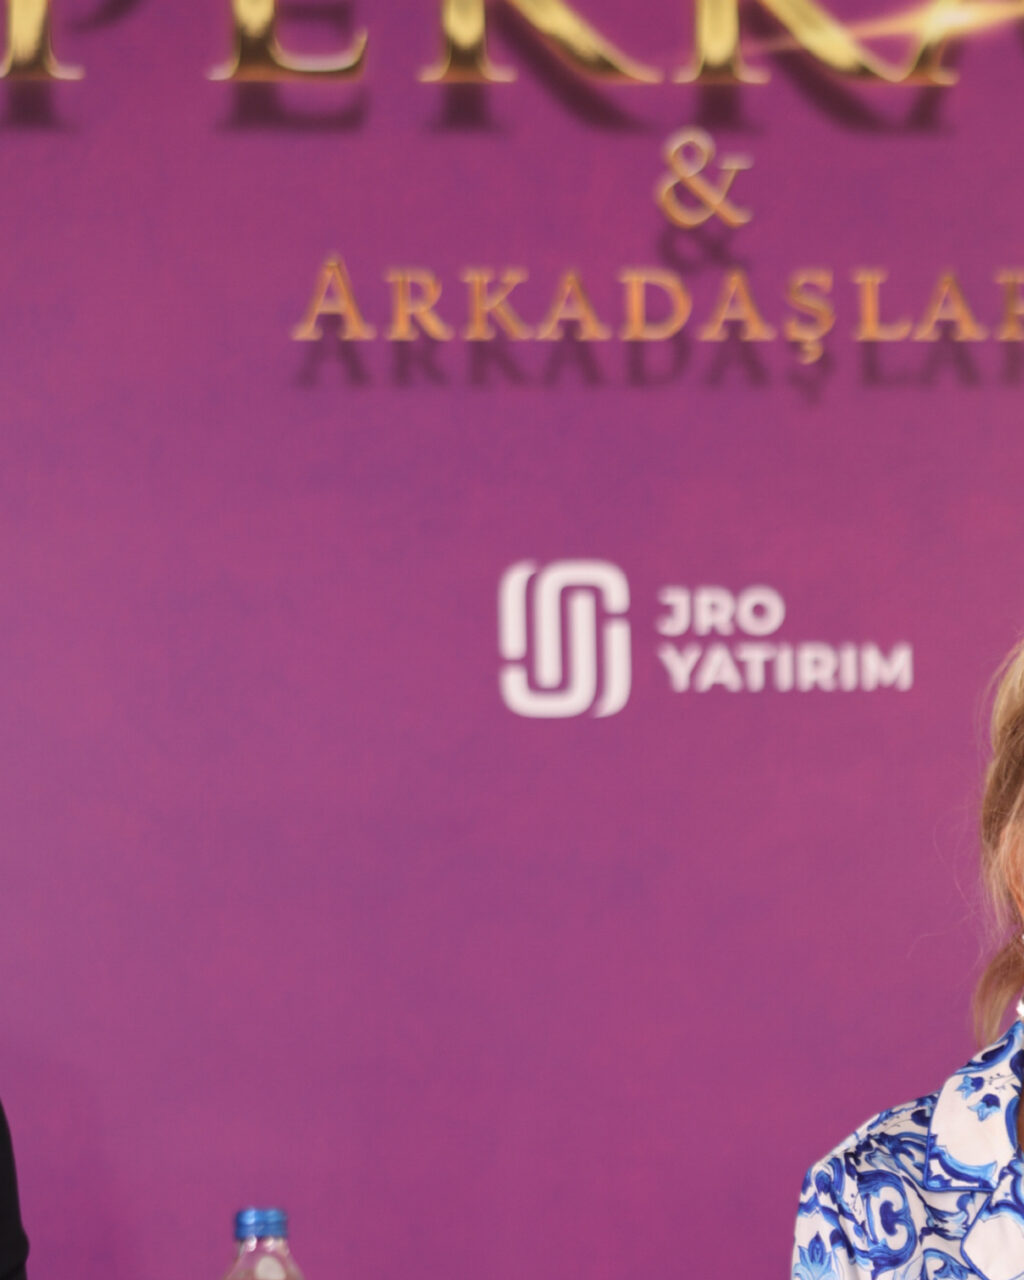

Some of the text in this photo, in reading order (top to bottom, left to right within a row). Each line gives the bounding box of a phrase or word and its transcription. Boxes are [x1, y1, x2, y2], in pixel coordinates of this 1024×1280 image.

[655, 128, 752, 228] &
[655, 585, 786, 637] JRO
[657, 640, 915, 694] YATIRIM
